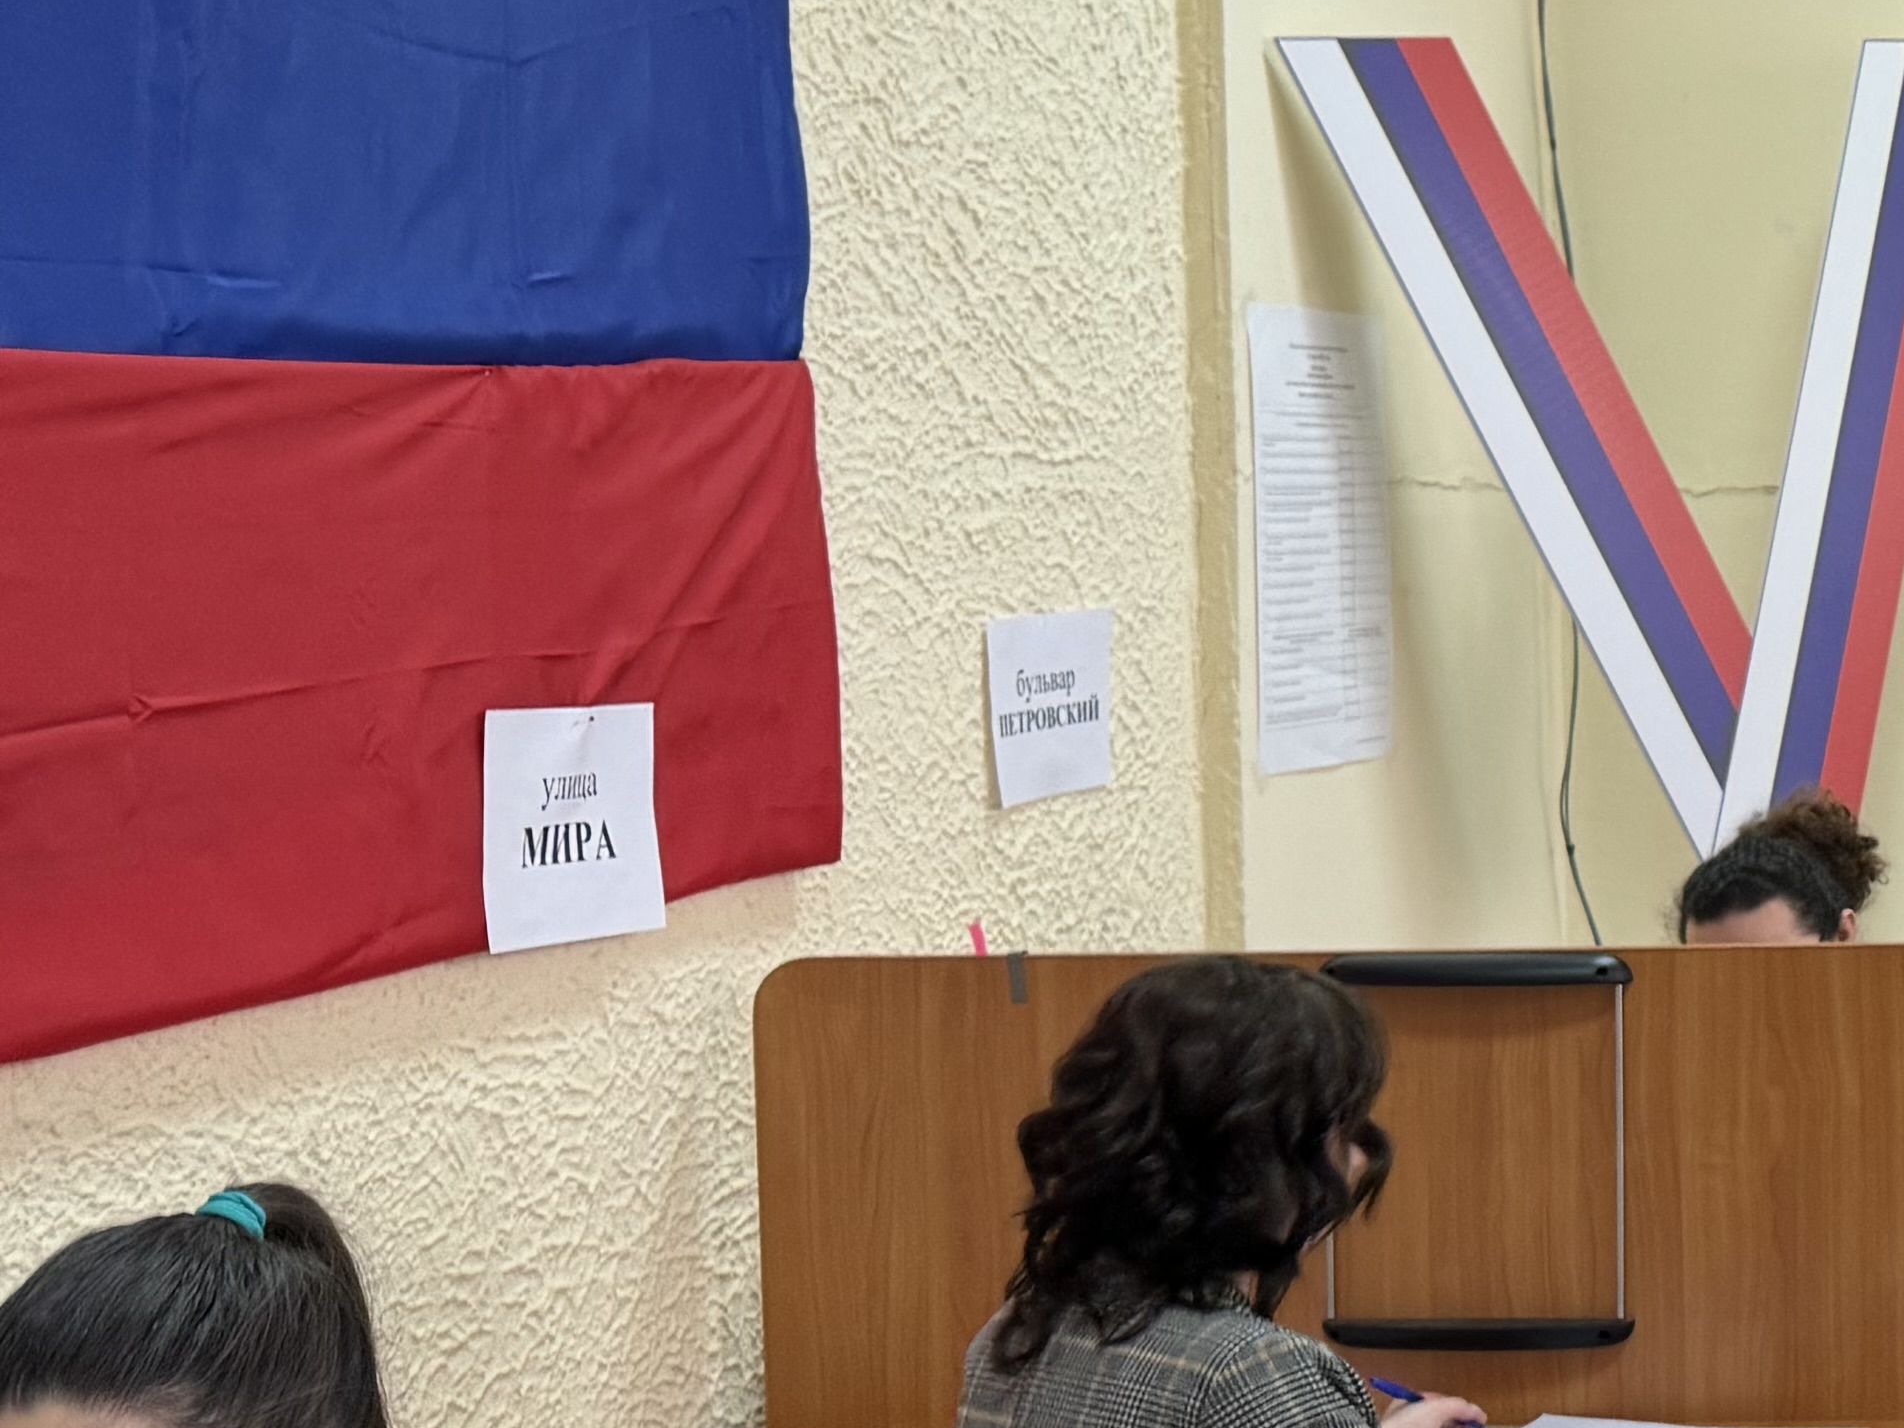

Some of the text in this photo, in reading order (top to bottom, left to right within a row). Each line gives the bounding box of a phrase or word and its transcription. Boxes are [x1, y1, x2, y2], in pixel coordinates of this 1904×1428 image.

[1016, 669, 1075, 703] бульвар
[999, 693, 1099, 738] ПЕТРОВСКИЙ
[541, 772, 597, 811] улица
[522, 818, 617, 869] МИРА
